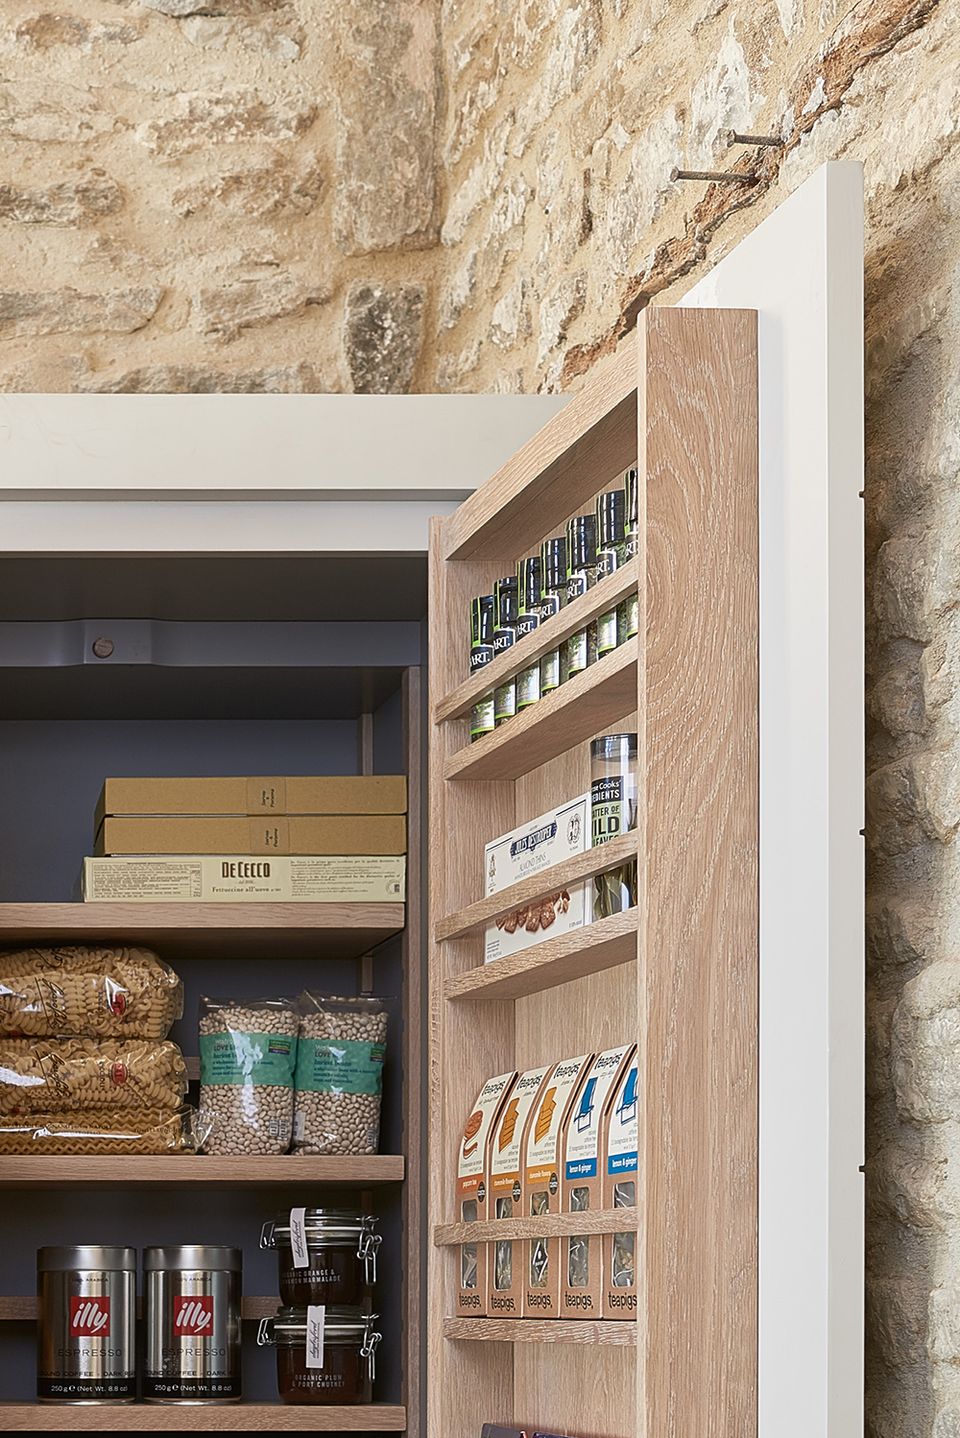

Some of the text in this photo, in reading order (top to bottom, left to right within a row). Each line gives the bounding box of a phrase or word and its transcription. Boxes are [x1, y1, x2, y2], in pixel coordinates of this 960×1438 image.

[610, 804, 620, 815] OF
[526, 1291, 553, 1310] teapigs.
[564, 1291, 594, 1311] teapigs.
[607, 1291, 638, 1311] teapigs
[72, 1302, 109, 1334] illy
[175, 1301, 212, 1334] illy
[58, 1348, 123, 1357] ESPRESSO
[162, 1348, 226, 1357] ESPRESSO
